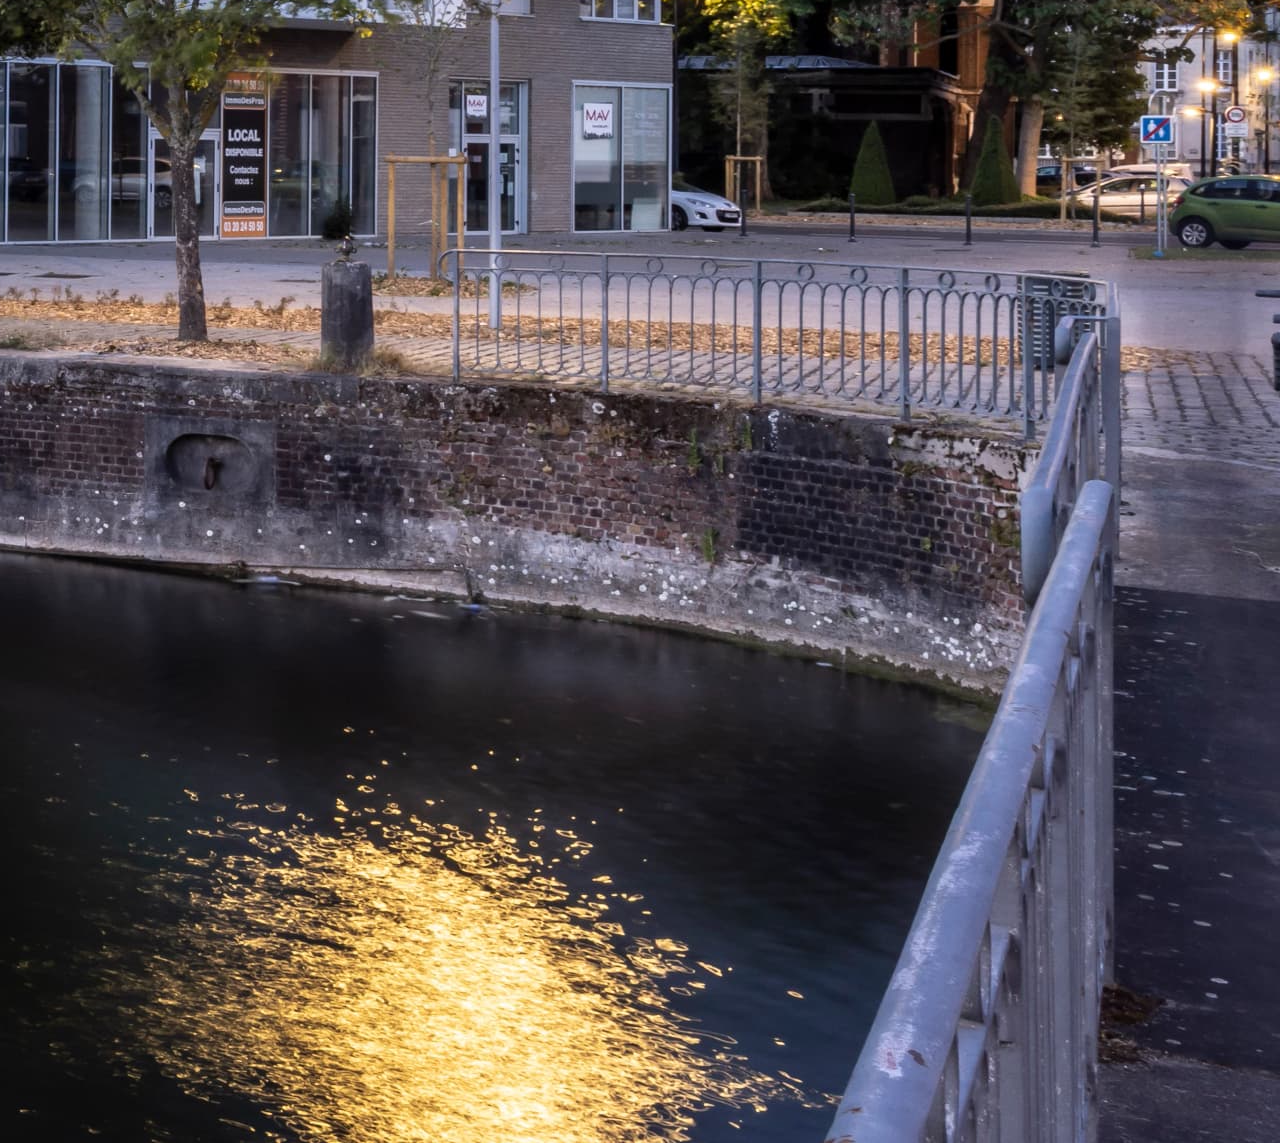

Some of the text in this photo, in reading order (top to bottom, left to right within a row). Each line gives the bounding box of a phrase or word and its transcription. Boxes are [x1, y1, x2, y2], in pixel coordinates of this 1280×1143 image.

[586, 109, 610, 121] MAV
[228, 129, 261, 142] LOCAL
[225, 148, 264, 157] DISPONIBLE
[229, 165, 259, 174] Contactez
